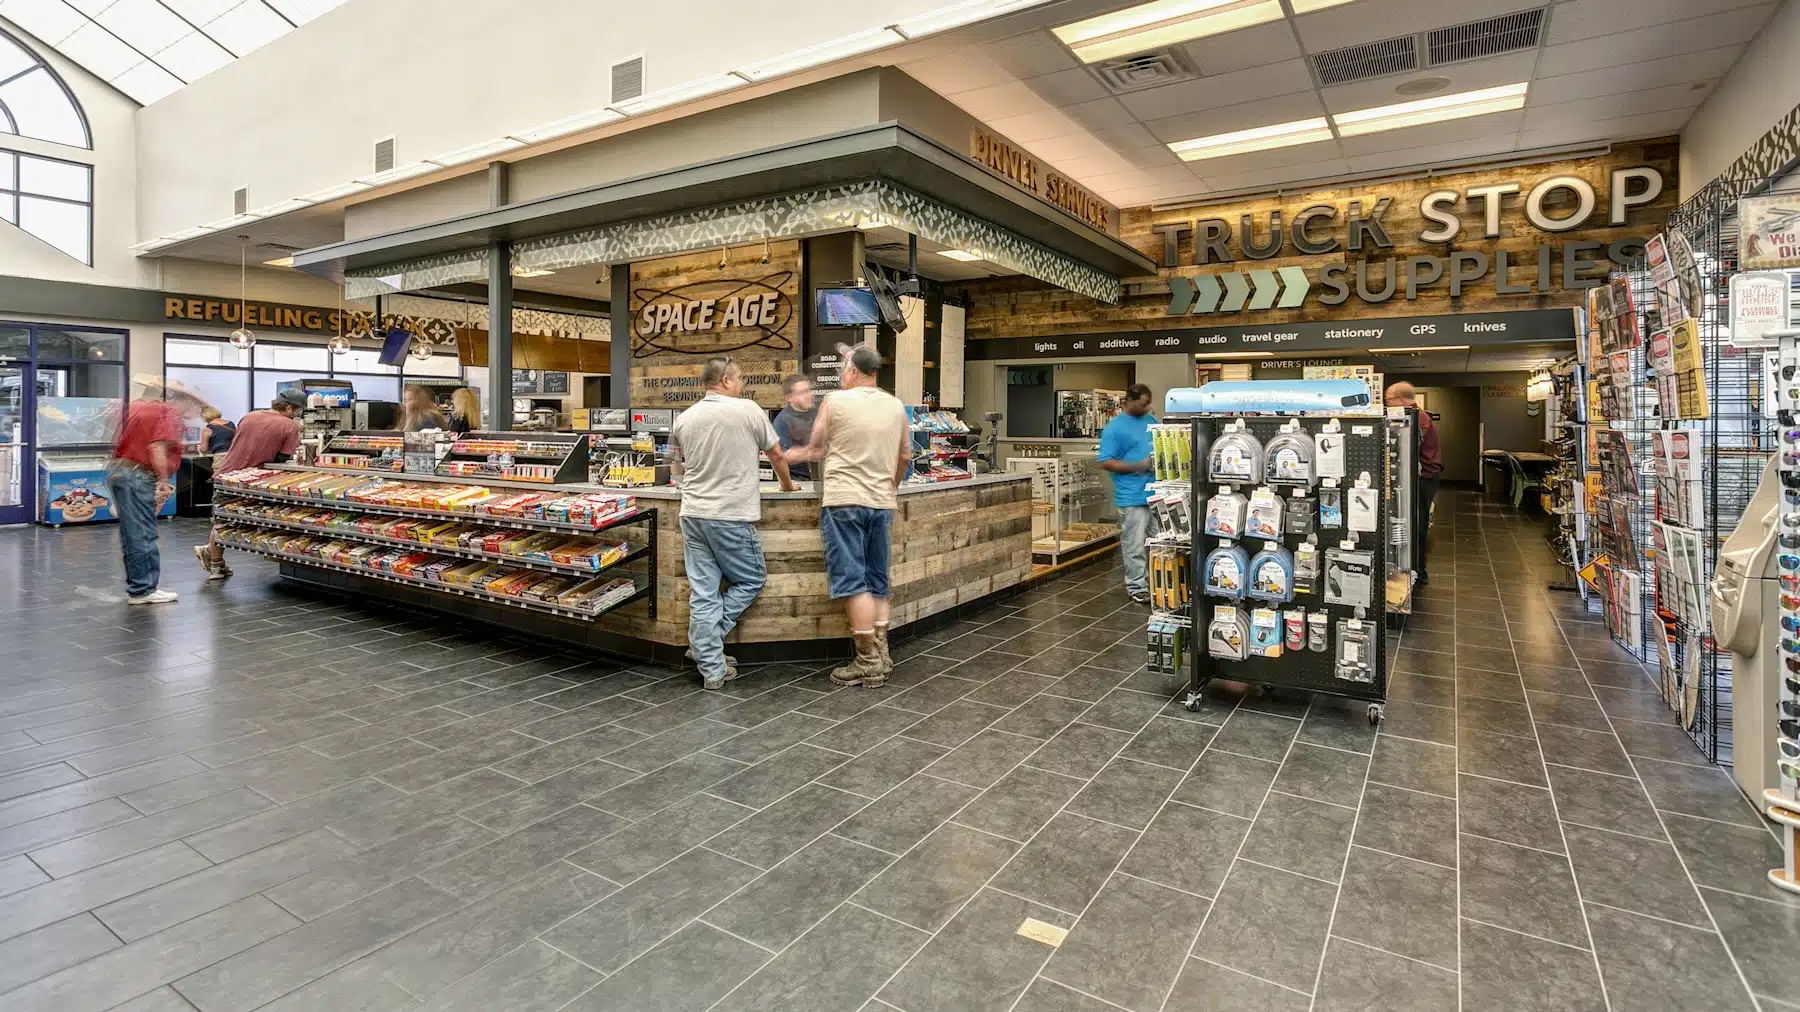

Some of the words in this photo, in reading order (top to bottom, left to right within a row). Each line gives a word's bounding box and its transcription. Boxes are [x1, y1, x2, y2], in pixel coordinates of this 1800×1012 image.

[970, 126, 1039, 193] DRIVER
[1046, 172, 1109, 232] SERVICES
[1152, 196, 1395, 268] TRUCK
[1418, 166, 1664, 244] STOP
[1768, 232, 1796, 245] We
[164, 297, 324, 329] REFUELING
[641, 299, 716, 335] SPACE
[720, 291, 779, 328] AGE
[1034, 341, 1057, 353] lights
[1073, 341, 1085, 350] oil
[1099, 339, 1139, 349] additives
[1155, 336, 1180, 346] radio
[1199, 334, 1227, 344] audio
[1242, 331, 1272, 342] travel
[1274, 331, 1298, 343] gear
[1324, 327, 1384, 340] stationery
[1410, 324, 1437, 336] GPS
[1463, 321, 1507, 334] knives
[1303, 358, 1343, 367] LOUNGE
[643, 377, 659, 388] THE
[741, 373, 783, 386] ORROW,
[663, 390, 699, 402] SERVING
[643, 414, 669, 425] Marlboro
